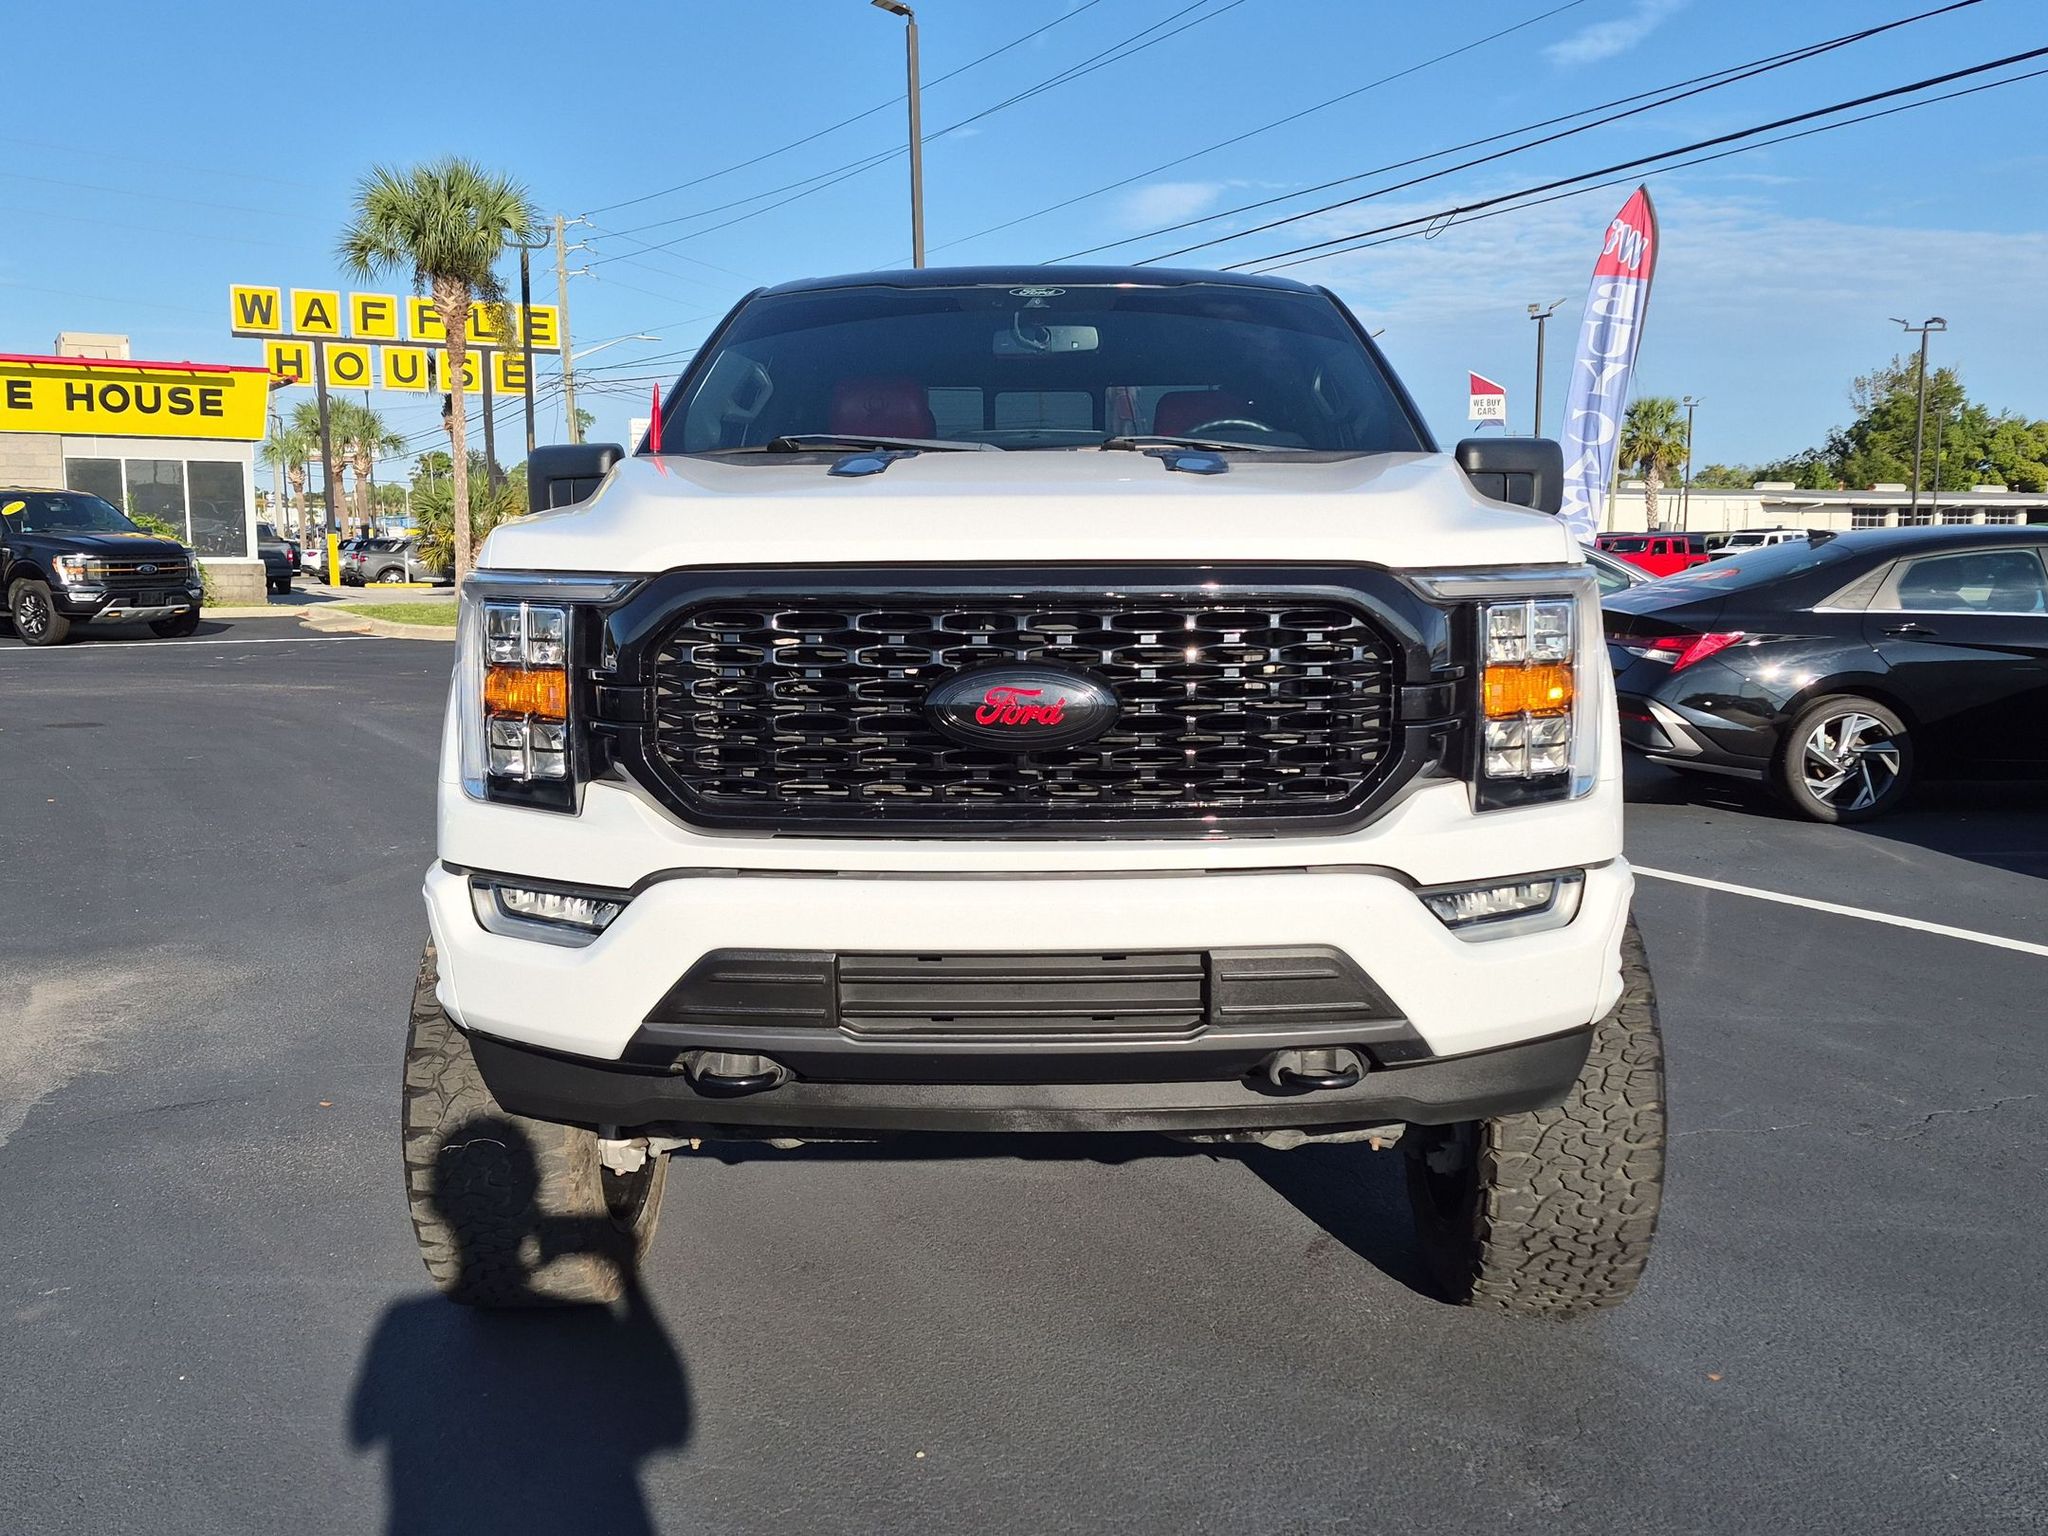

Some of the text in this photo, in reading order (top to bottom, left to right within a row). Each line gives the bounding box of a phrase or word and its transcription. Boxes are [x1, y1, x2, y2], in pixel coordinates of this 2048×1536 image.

[238, 293, 550, 342] WAFFLE
[65, 381, 224, 417] HOUSE
[1473, 398, 1501, 407] WE BUY
[1477, 407, 1497, 416] CARS
[975, 685, 1068, 726] Ford
